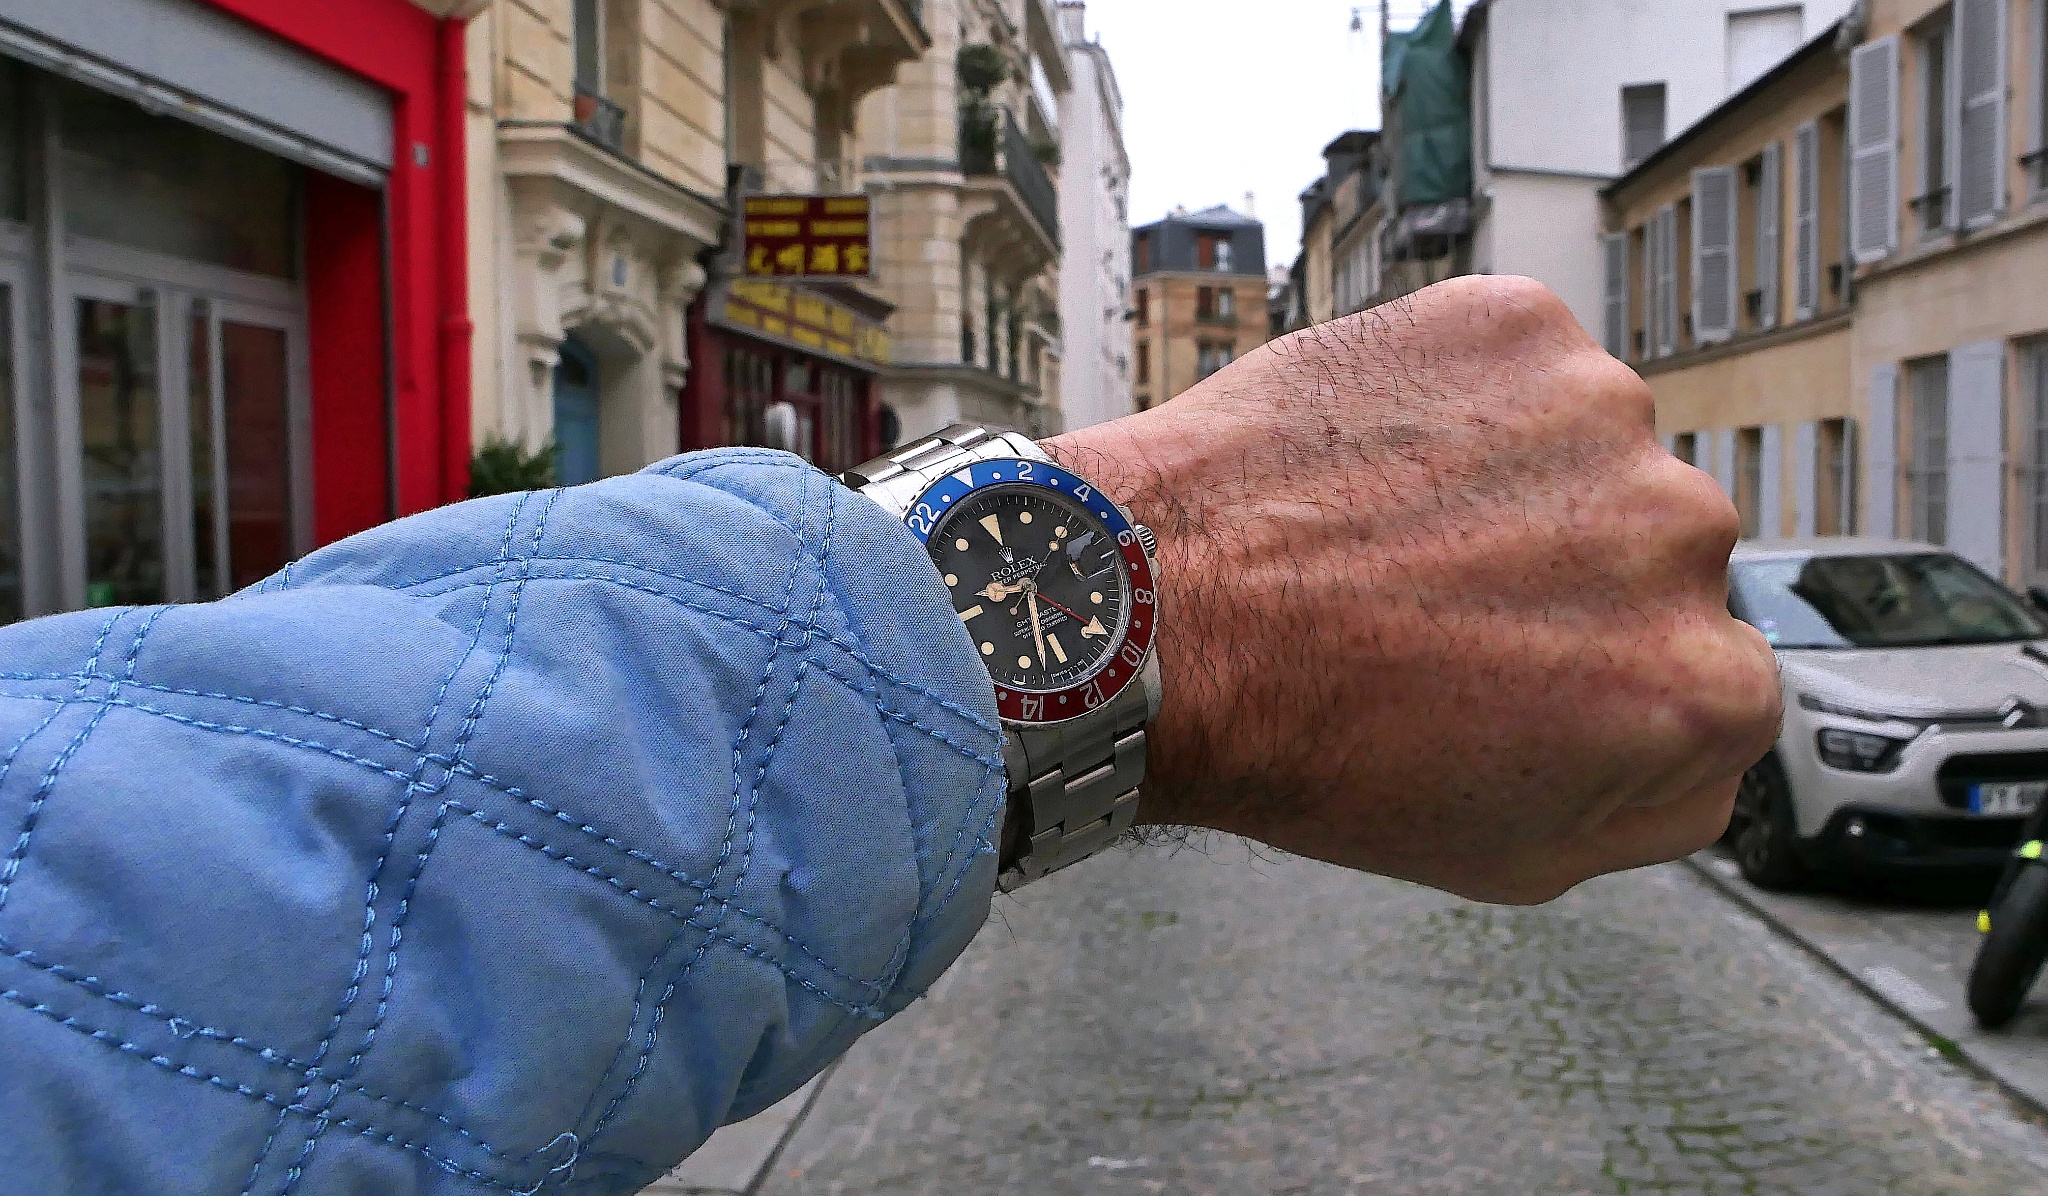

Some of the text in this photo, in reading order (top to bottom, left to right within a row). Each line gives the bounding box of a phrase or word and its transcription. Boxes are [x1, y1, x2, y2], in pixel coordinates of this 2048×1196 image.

[1016, 461, 1034, 481] 2
[1073, 484, 1092, 502] 4
[907, 502, 942, 535] 22
[1117, 529, 1136, 547] 6
[990, 555, 1038, 581] ROLEX
[1134, 587, 1154, 605] 8
[1120, 639, 1144, 667] 10
[1079, 678, 1106, 708] 12
[1020, 695, 1044, 721] 14
